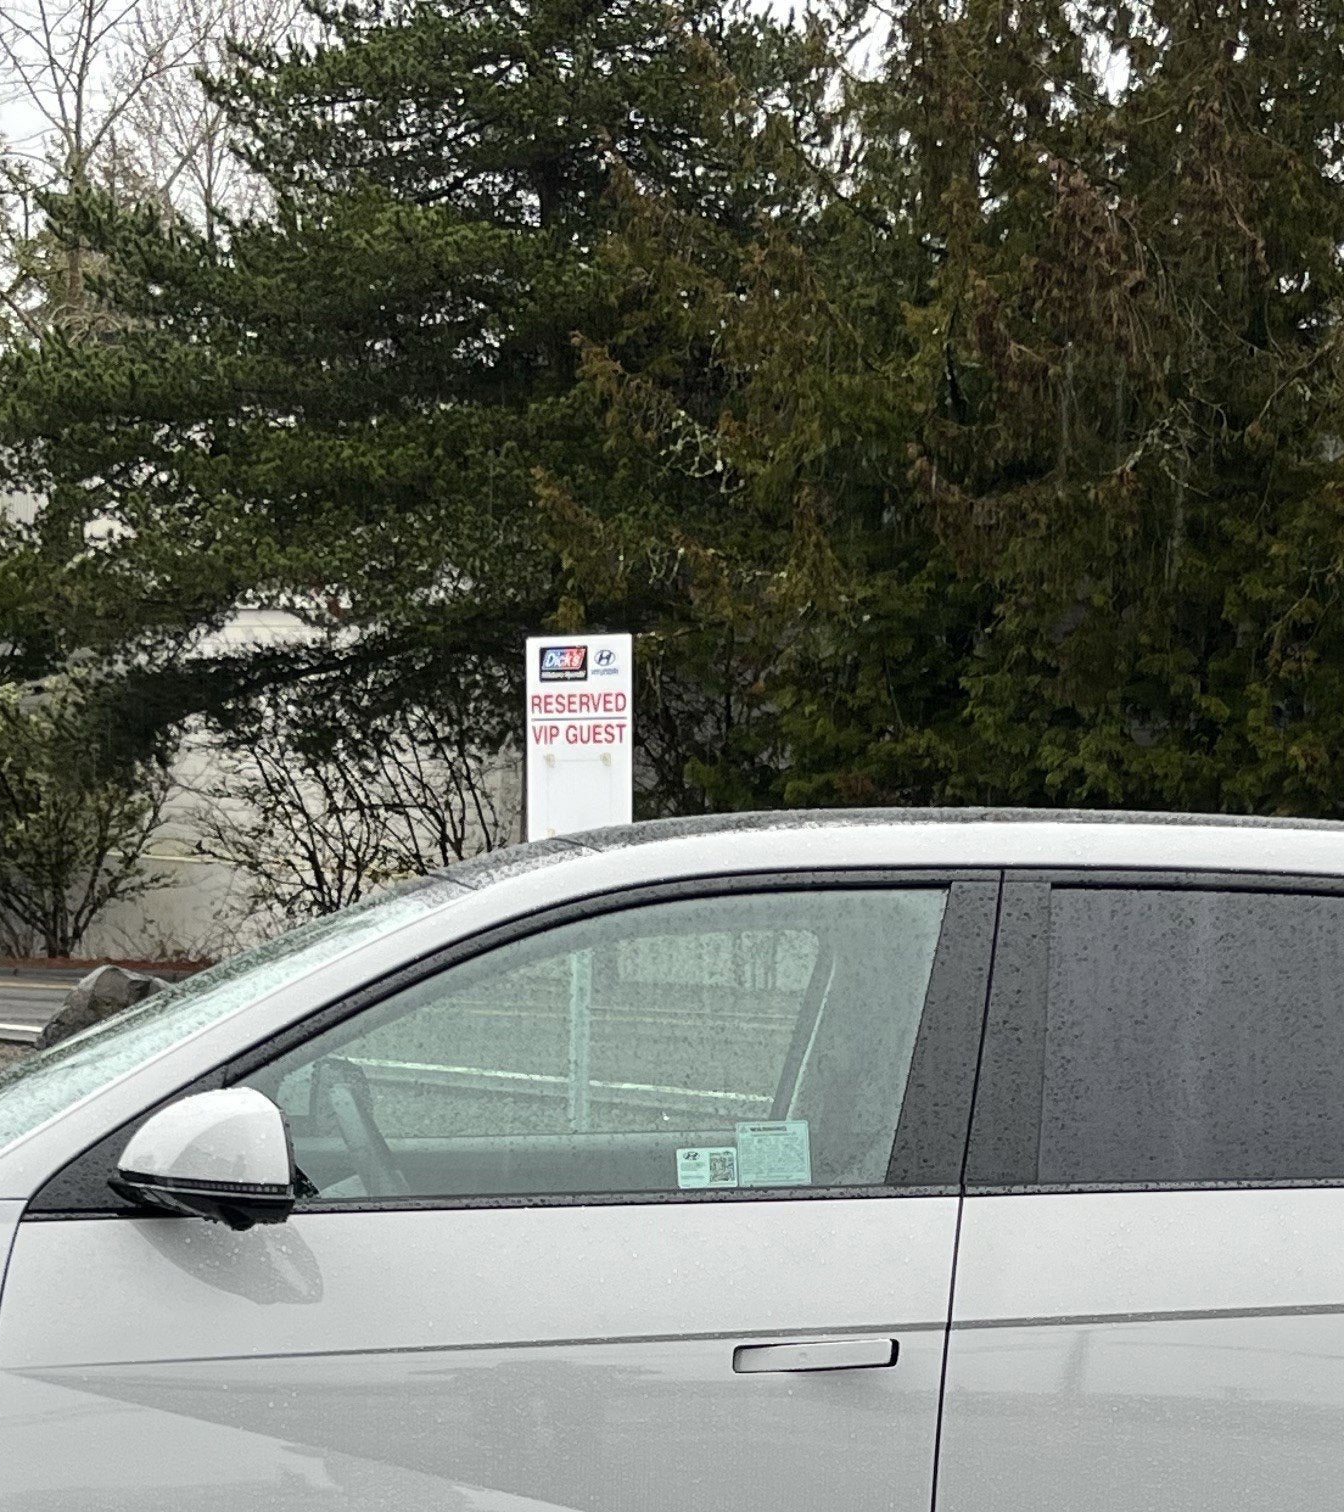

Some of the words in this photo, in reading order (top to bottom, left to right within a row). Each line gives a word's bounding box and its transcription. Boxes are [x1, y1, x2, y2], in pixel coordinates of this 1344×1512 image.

[531, 691, 627, 714] RESERVED
[532, 725, 560, 745] VIP
[565, 723, 627, 745] GUEST
